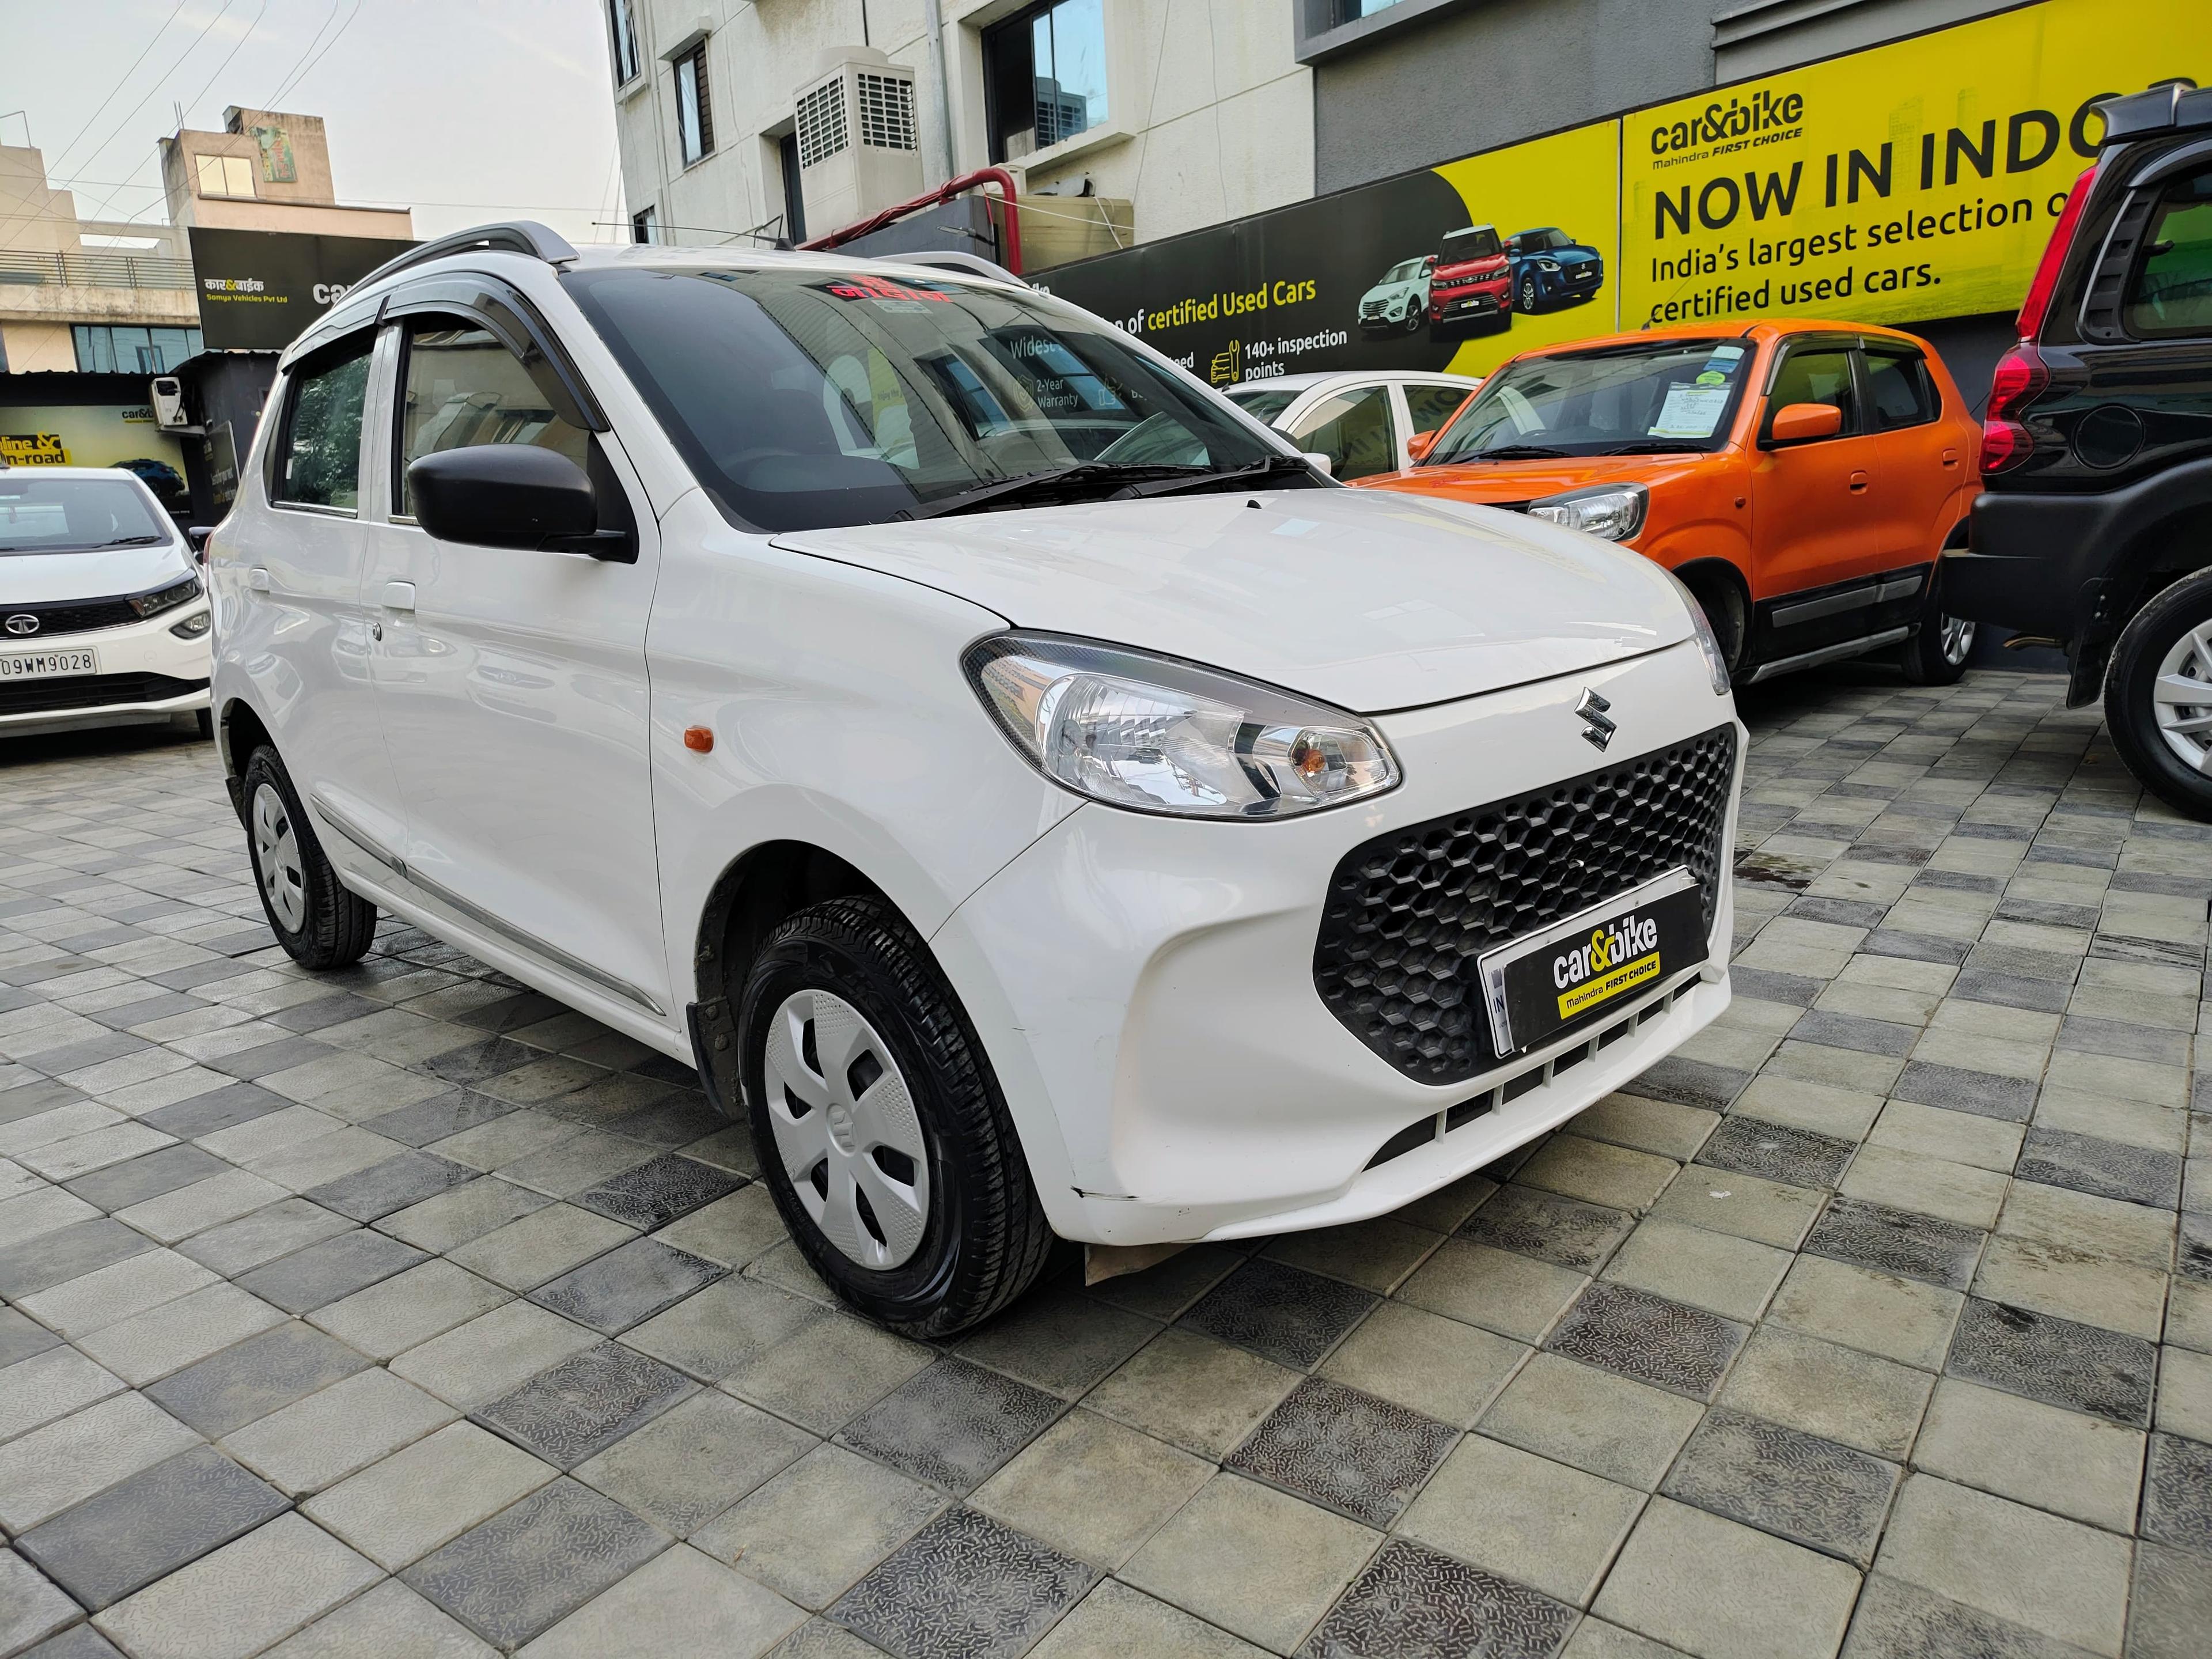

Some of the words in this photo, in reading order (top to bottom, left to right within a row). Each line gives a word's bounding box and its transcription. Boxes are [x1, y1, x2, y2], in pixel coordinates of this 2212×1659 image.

[1652, 90, 1804, 156] car&bike
[1653, 152, 1709, 170] Mahindra
[1712, 140, 1751, 157] FIRST
[1752, 127, 1803, 147] CHOICE
[1655, 161, 1804, 240] NOW
[1825, 142, 1893, 208] IN
[1652, 244, 1738, 282] India's
[1749, 225, 1857, 266] largest
[1867, 198, 2033, 247] selection
[206, 294, 232, 302] Somya
[232, 294, 263, 302] Vehicles
[1127, 309, 1145, 335] of
[1147, 293, 1218, 330] certified
[1222, 282, 1268, 316] Used
[1272, 280, 1316, 306] Cars
[1650, 279, 1770, 324] certified
[1780, 266, 1853, 305] used
[1863, 263, 1941, 293] cars.
[1010, 336, 1055, 359] Widest
[1244, 341, 1275, 359] 140+
[1277, 329, 1347, 355] inspection
[1036, 379, 1064, 392] 2-Year
[1245, 361, 1285, 382] points
[1037, 393, 1079, 408] Warranty
[1553, 915, 1658, 989] car&bike
[1566, 987, 1604, 1009] Mahindra
[1605, 974, 1628, 991] FIRST
[1628, 960, 1657, 980] CHOICE
